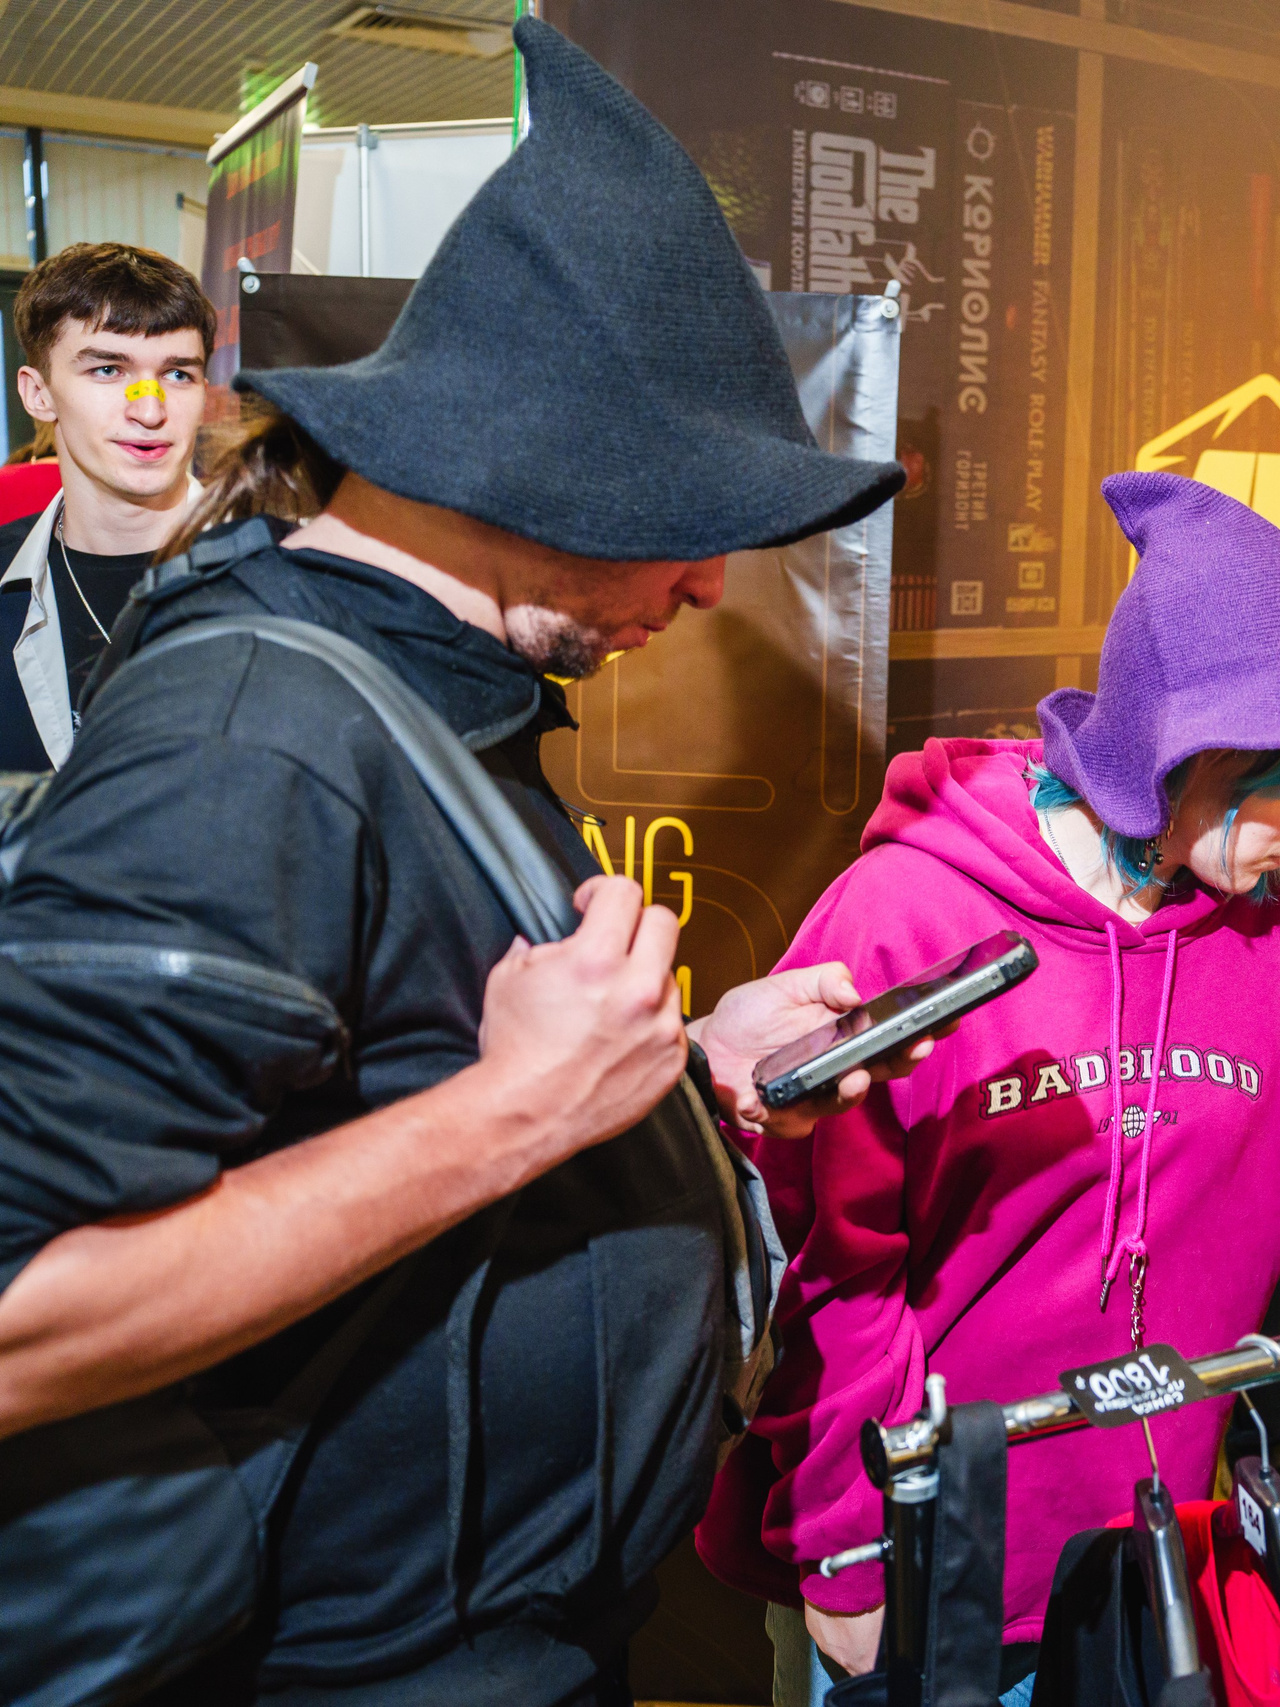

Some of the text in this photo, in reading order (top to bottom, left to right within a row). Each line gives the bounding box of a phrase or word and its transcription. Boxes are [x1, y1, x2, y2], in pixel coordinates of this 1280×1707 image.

[790, 129, 806, 292] ИМПЕРИЯ КОРЛЕ
[810, 131, 877, 294] Godfath
[878, 145, 938, 224] The
[1032, 125, 1055, 265] WARHAMMER
[958, 174, 994, 414] КОРИОЛИС
[1030, 279, 1050, 382] FANTASY
[954, 450, 971, 531] ГОРИЗОНТ
[970, 460, 988, 521] ТРЕТИЙ
